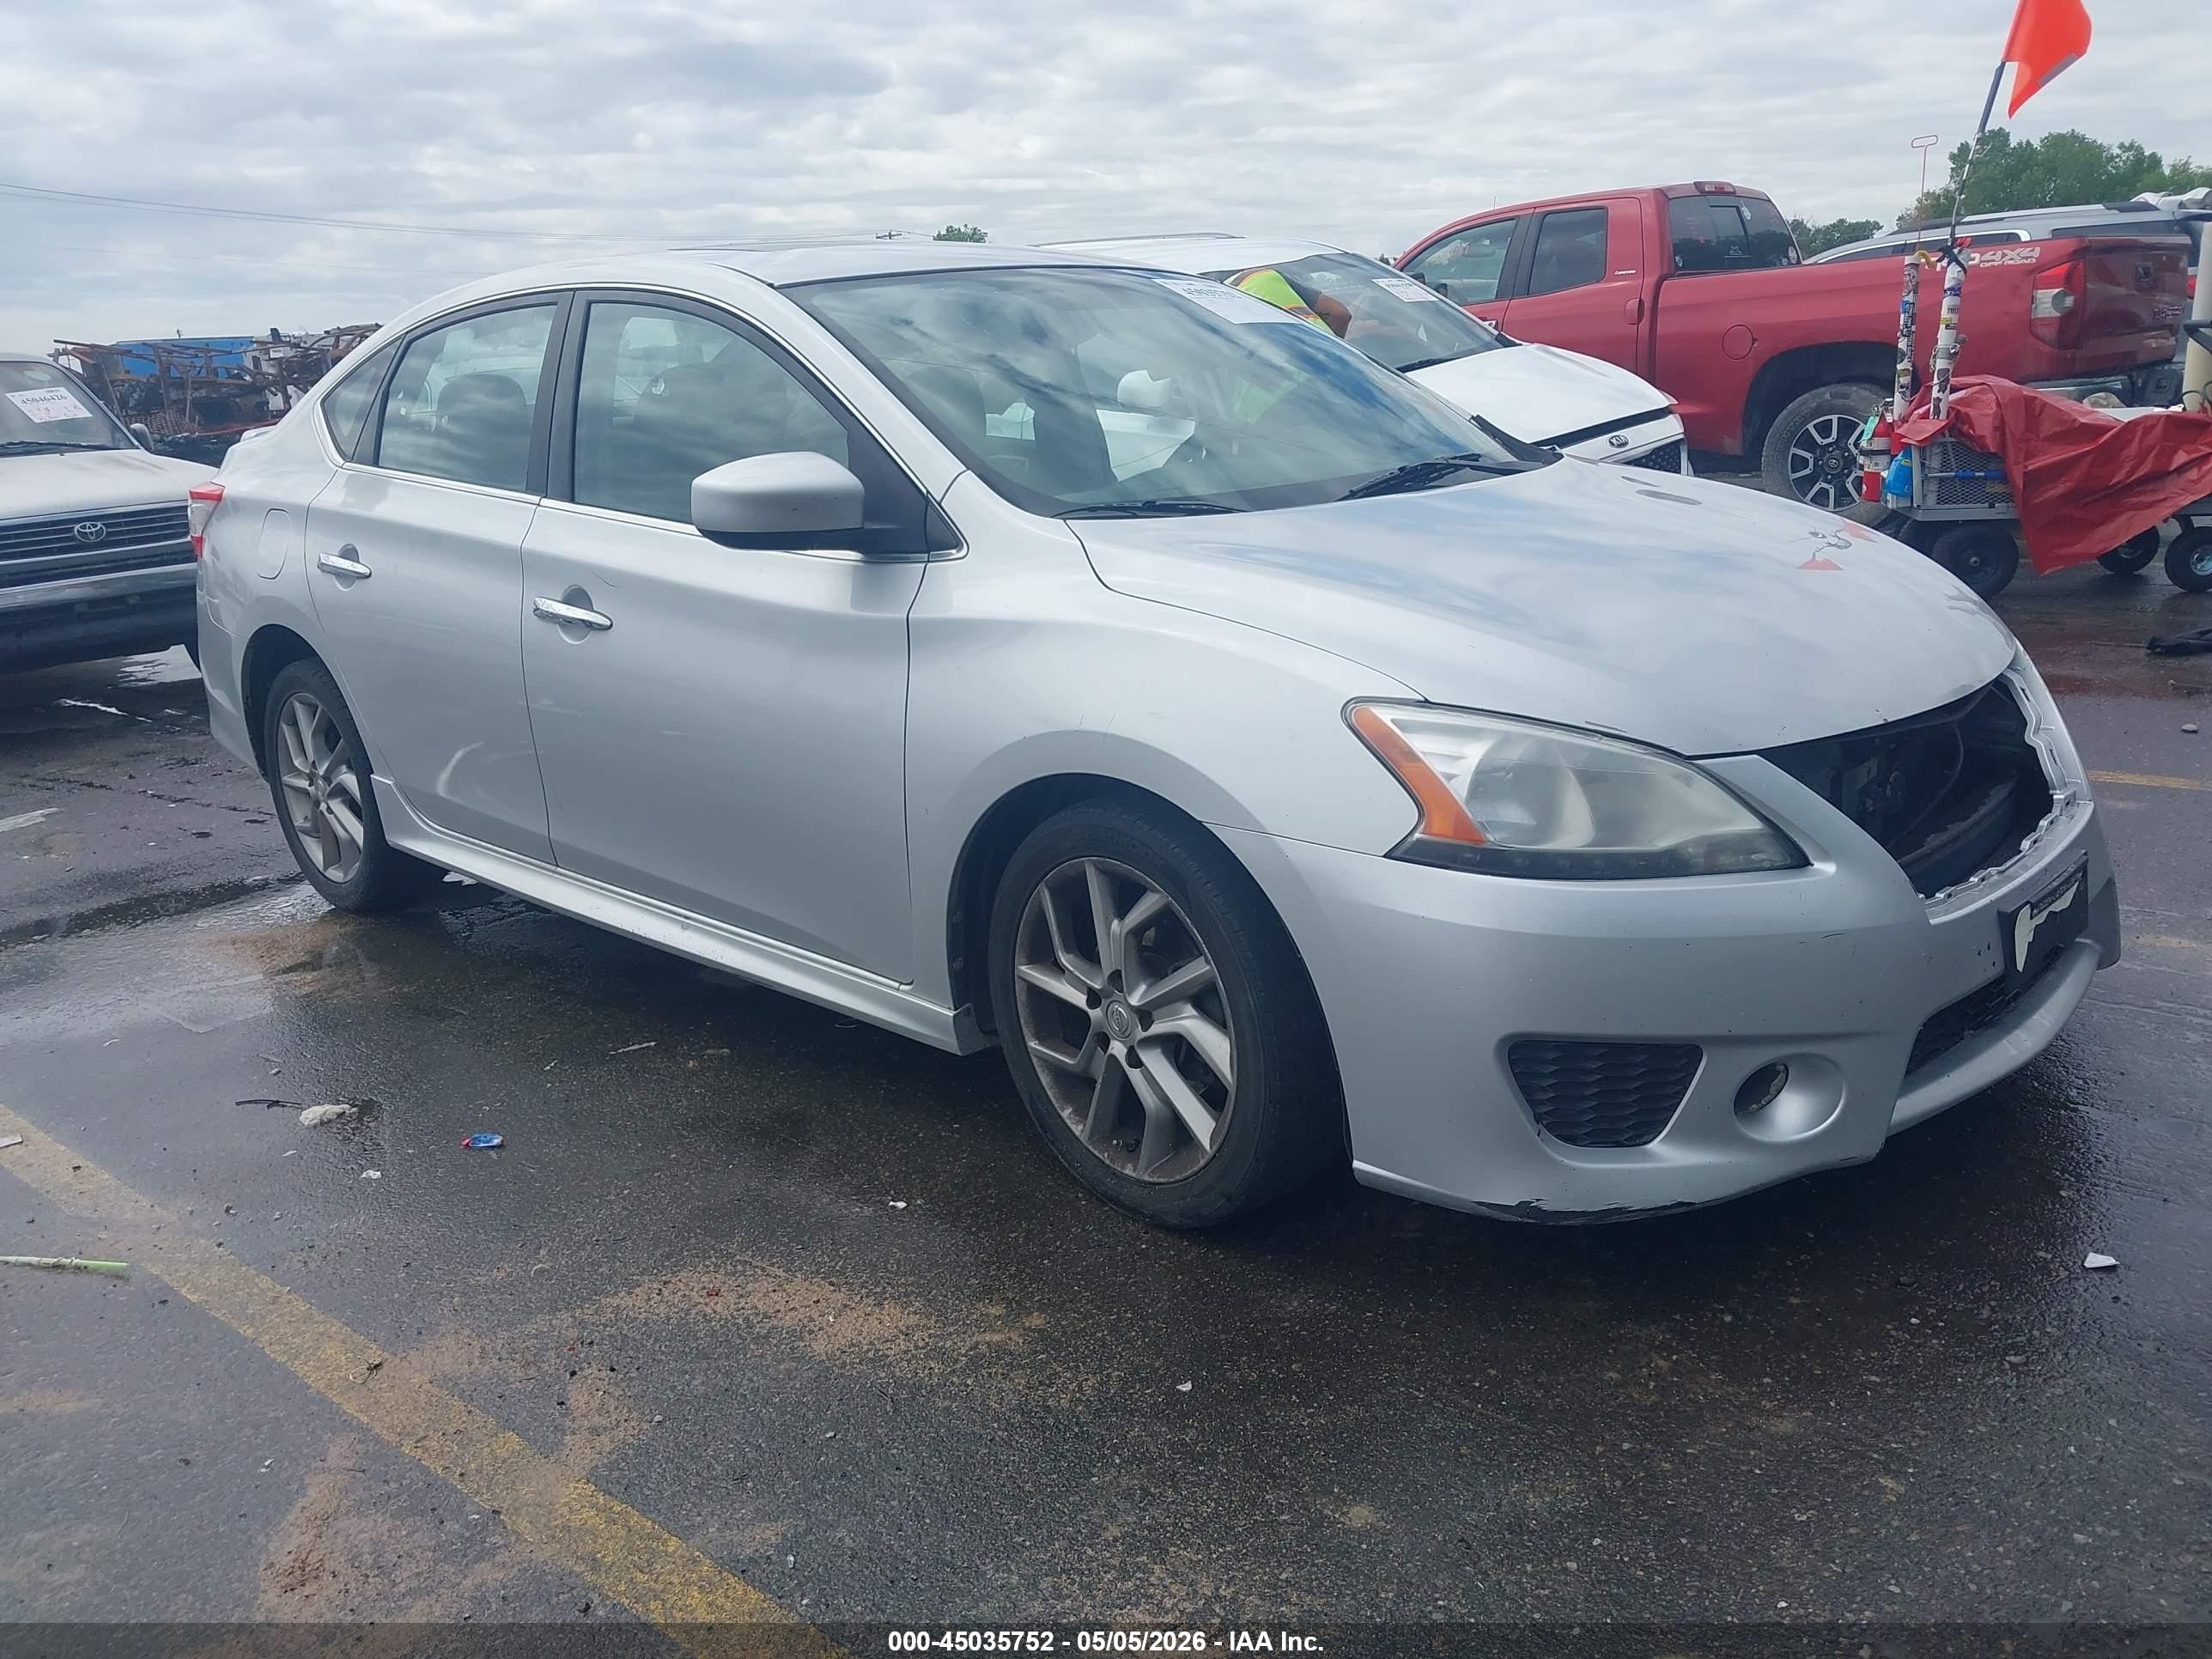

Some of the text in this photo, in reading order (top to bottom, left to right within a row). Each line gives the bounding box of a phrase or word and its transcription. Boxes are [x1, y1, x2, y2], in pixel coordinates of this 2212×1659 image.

[1980, 246, 2040, 262] 4X4
[21, 394, 68, 404] 45046426
[1610, 436, 1628, 447] KIA
